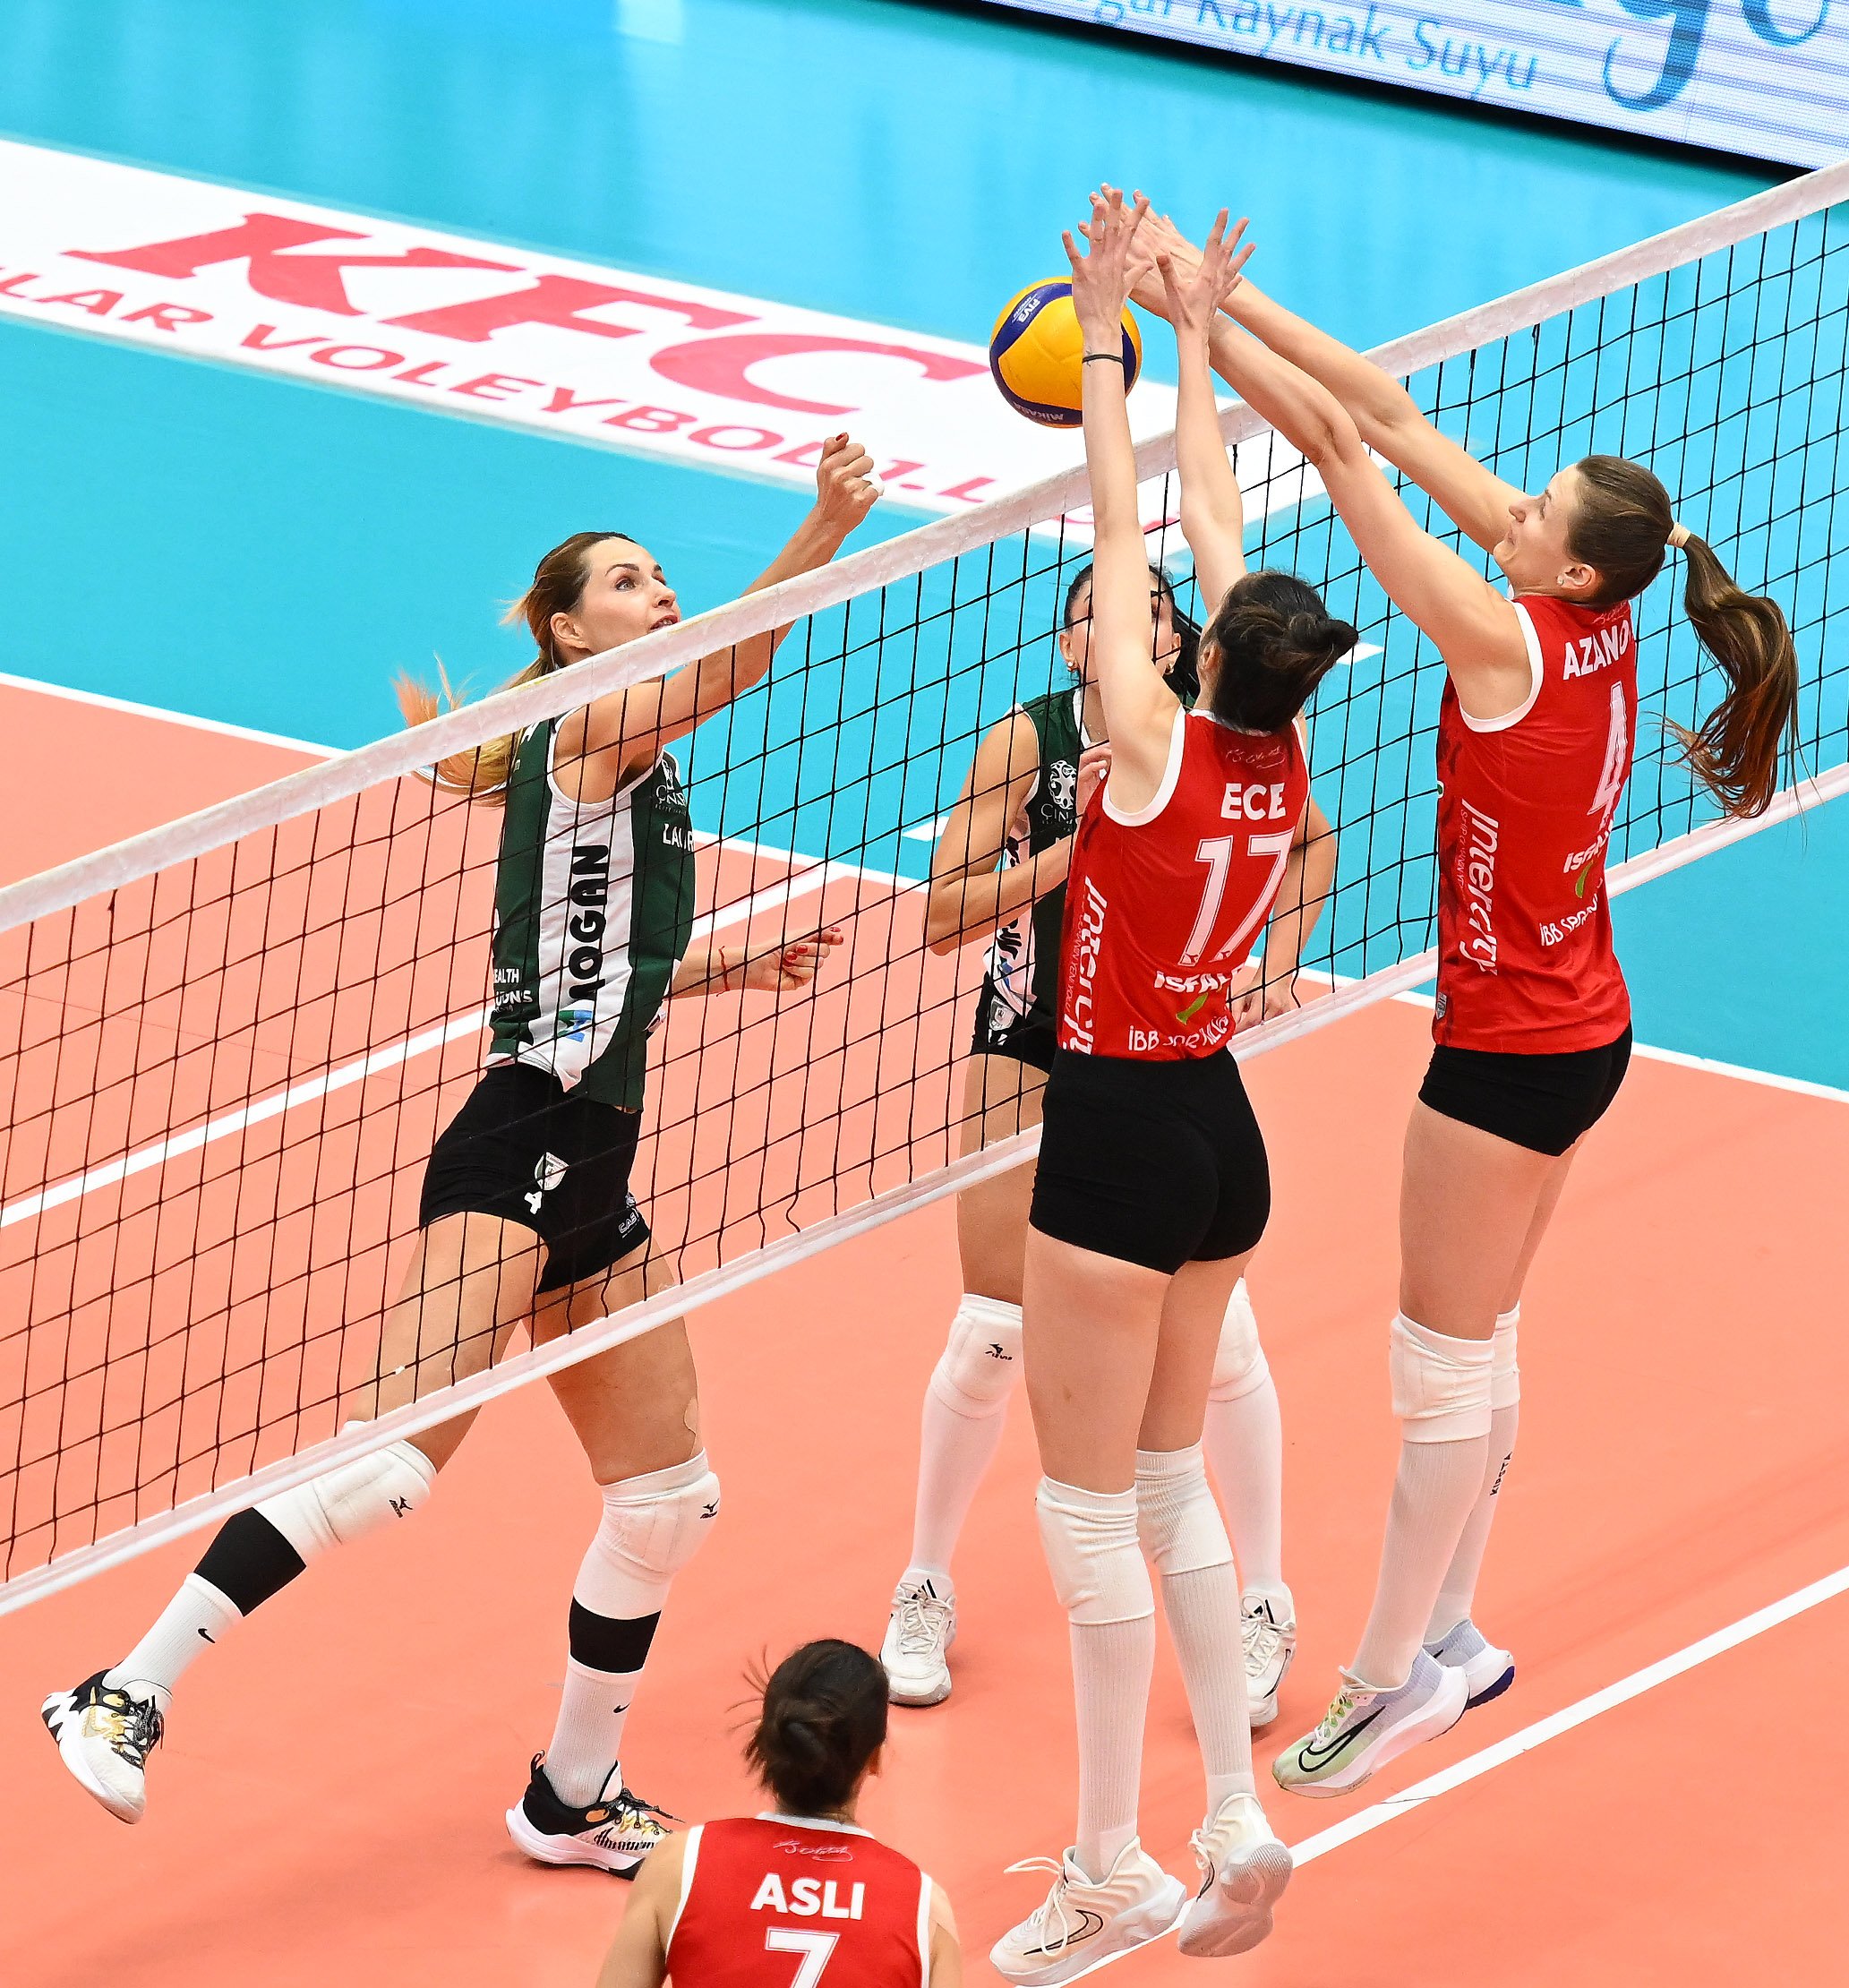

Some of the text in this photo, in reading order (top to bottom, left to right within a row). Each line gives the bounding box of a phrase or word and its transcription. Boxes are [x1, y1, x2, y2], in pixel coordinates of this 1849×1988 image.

[1196, 0, 1391, 60] Kaynak
[1408, 17, 1537, 100] Suyu
[59, 211, 990, 416] KFC
[0, 272, 214, 331] LAR
[239, 323, 825, 467] VOLEYBOL
[1562, 619, 1631, 681] AZANO
[1587, 681, 1628, 833] 4
[1220, 782, 1287, 821] ECE
[1177, 825, 1297, 967] 17
[1128, 1024, 1160, 1051] İBB
[750, 1872, 866, 1921] ASLI
[765, 1926, 841, 1988] 7
